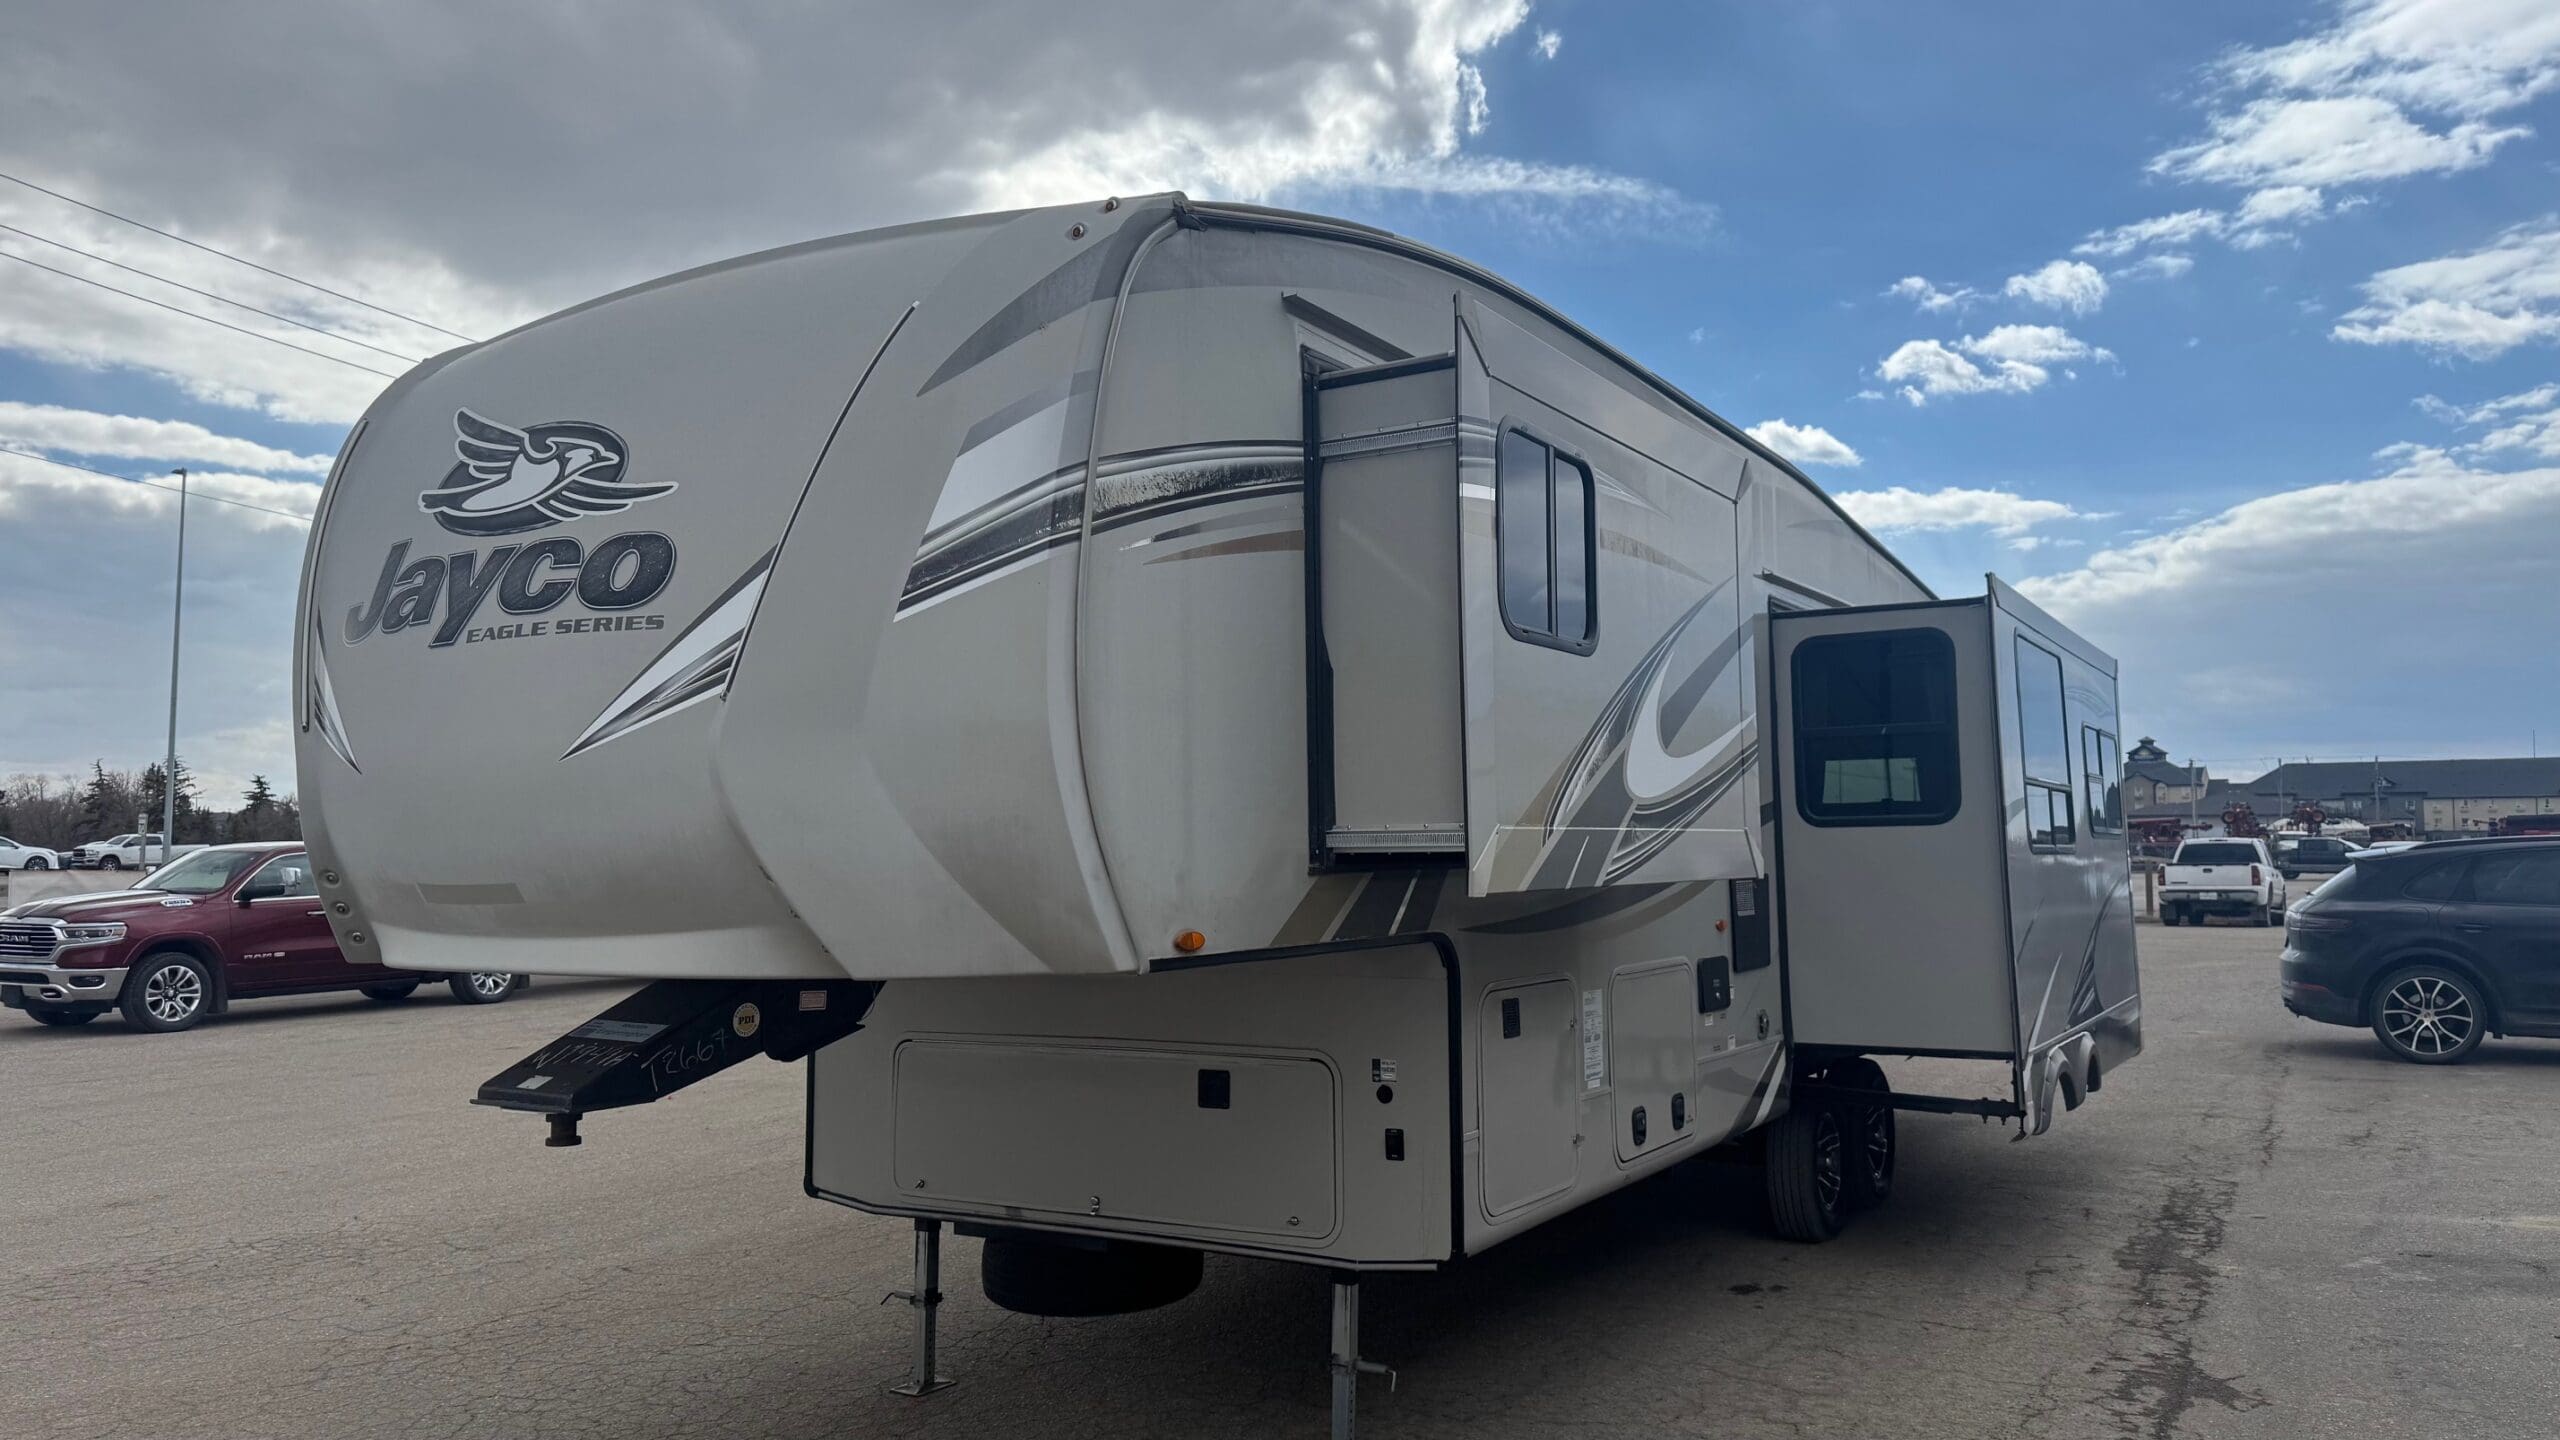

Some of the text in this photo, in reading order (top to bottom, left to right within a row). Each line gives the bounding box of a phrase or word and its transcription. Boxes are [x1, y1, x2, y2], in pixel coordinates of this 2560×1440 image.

[343, 531, 678, 648] Jayco
[465, 614, 665, 644] EAGLE SERIES
[2, 934, 29, 945] RAM
[738, 1014, 755, 1025] PDI
